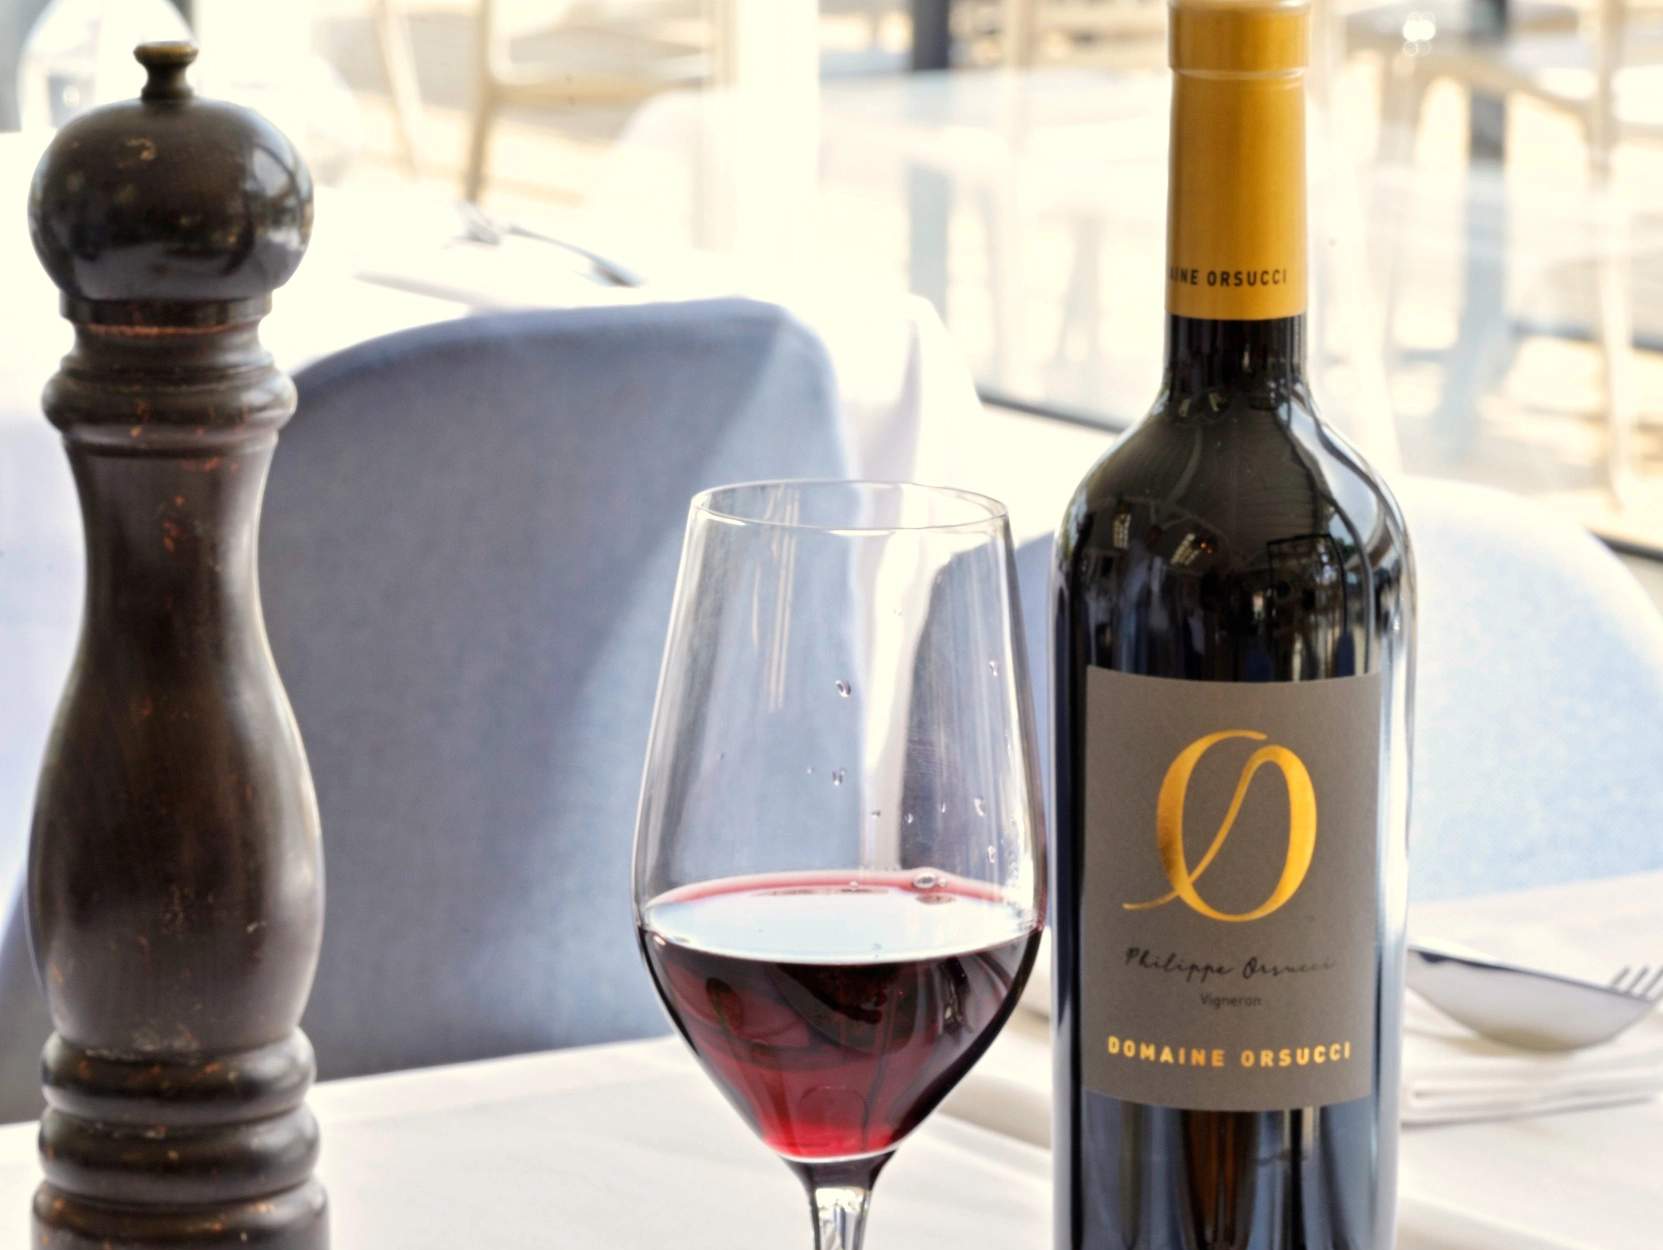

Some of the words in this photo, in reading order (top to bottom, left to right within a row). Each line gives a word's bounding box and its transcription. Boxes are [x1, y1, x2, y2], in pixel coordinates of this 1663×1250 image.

[1207, 269, 1287, 287] ORSUCCI
[1125, 946, 1234, 983] Philippe
[1241, 956, 1336, 980] Orsucci
[1200, 992, 1262, 1009] Vigneron
[1107, 1035, 1225, 1067] DOMAINE
[1240, 1041, 1351, 1067] ORSUCCI
